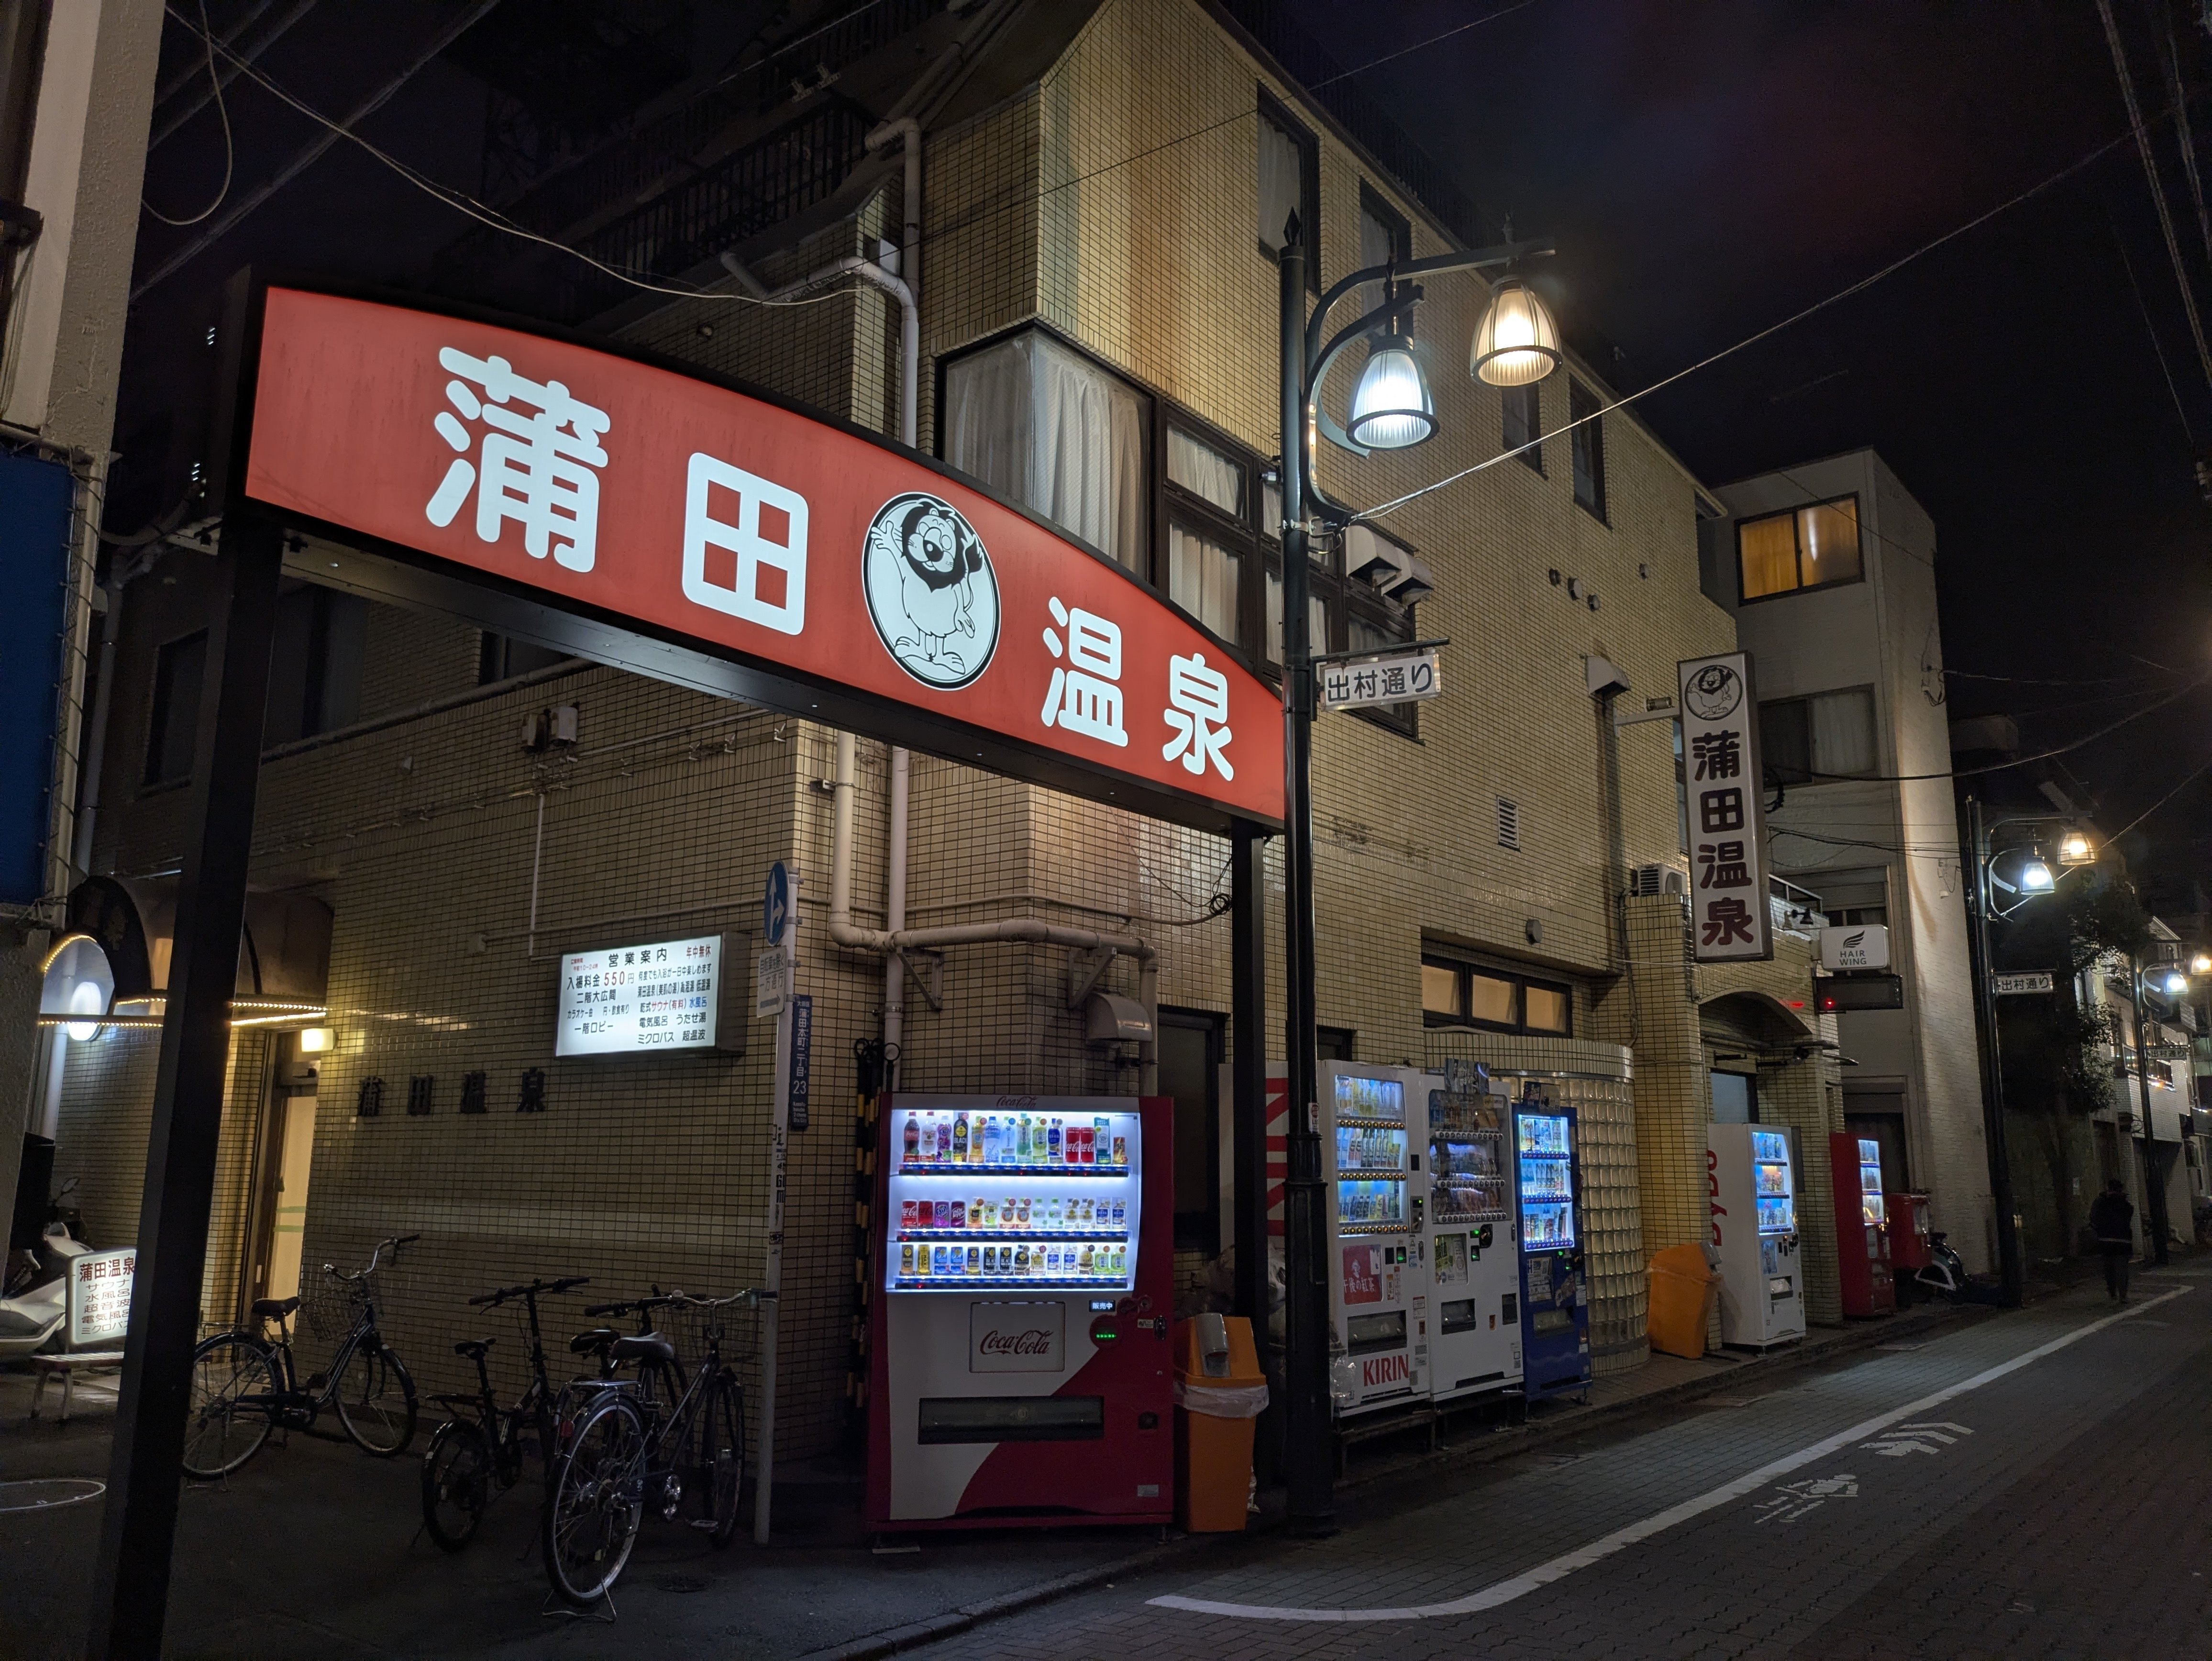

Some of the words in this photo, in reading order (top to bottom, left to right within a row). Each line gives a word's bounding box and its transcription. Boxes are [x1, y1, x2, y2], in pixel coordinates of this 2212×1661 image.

[1327, 663, 1433, 702] 出村通り
[1692, 730, 1754, 946] 蒲田温泉
[608, 947, 667, 967] 営業案内
[686, 944, 711, 959] 年中無休
[1840, 950, 1866, 958] HAIR
[1839, 958, 1867, 966] WING
[639, 963, 711, 981] 何度でも入浴が一日中楽しめます
[2002, 976, 2049, 991] 出村通り
[576, 989, 617, 1004] 二階大広間
[689, 996, 707, 1008] 水風呂
[574, 1020, 613, 1034] 一階ロビー
[639, 1015, 668, 1028] 電気風呂
[676, 1012, 707, 1025] うたせ湯
[638, 1031, 675, 1044] ミクロバス
[796, 1008, 807, 1076] 蒲田本町二丁目
[793, 1080, 807, 1095] 23
[79, 1257, 134, 1282] 蒲田温泉
[86, 1279, 130, 1292] サウナ
[85, 1288, 130, 1302] 水風呂
[84, 1298, 130, 1314] 超音波
[1092, 1302, 1113, 1310] 販売中
[81, 1309, 129, 1324] 電気風呂
[979, 1329, 1053, 1355] Coca-Cola
[1363, 1353, 1409, 1387] KIRIN
